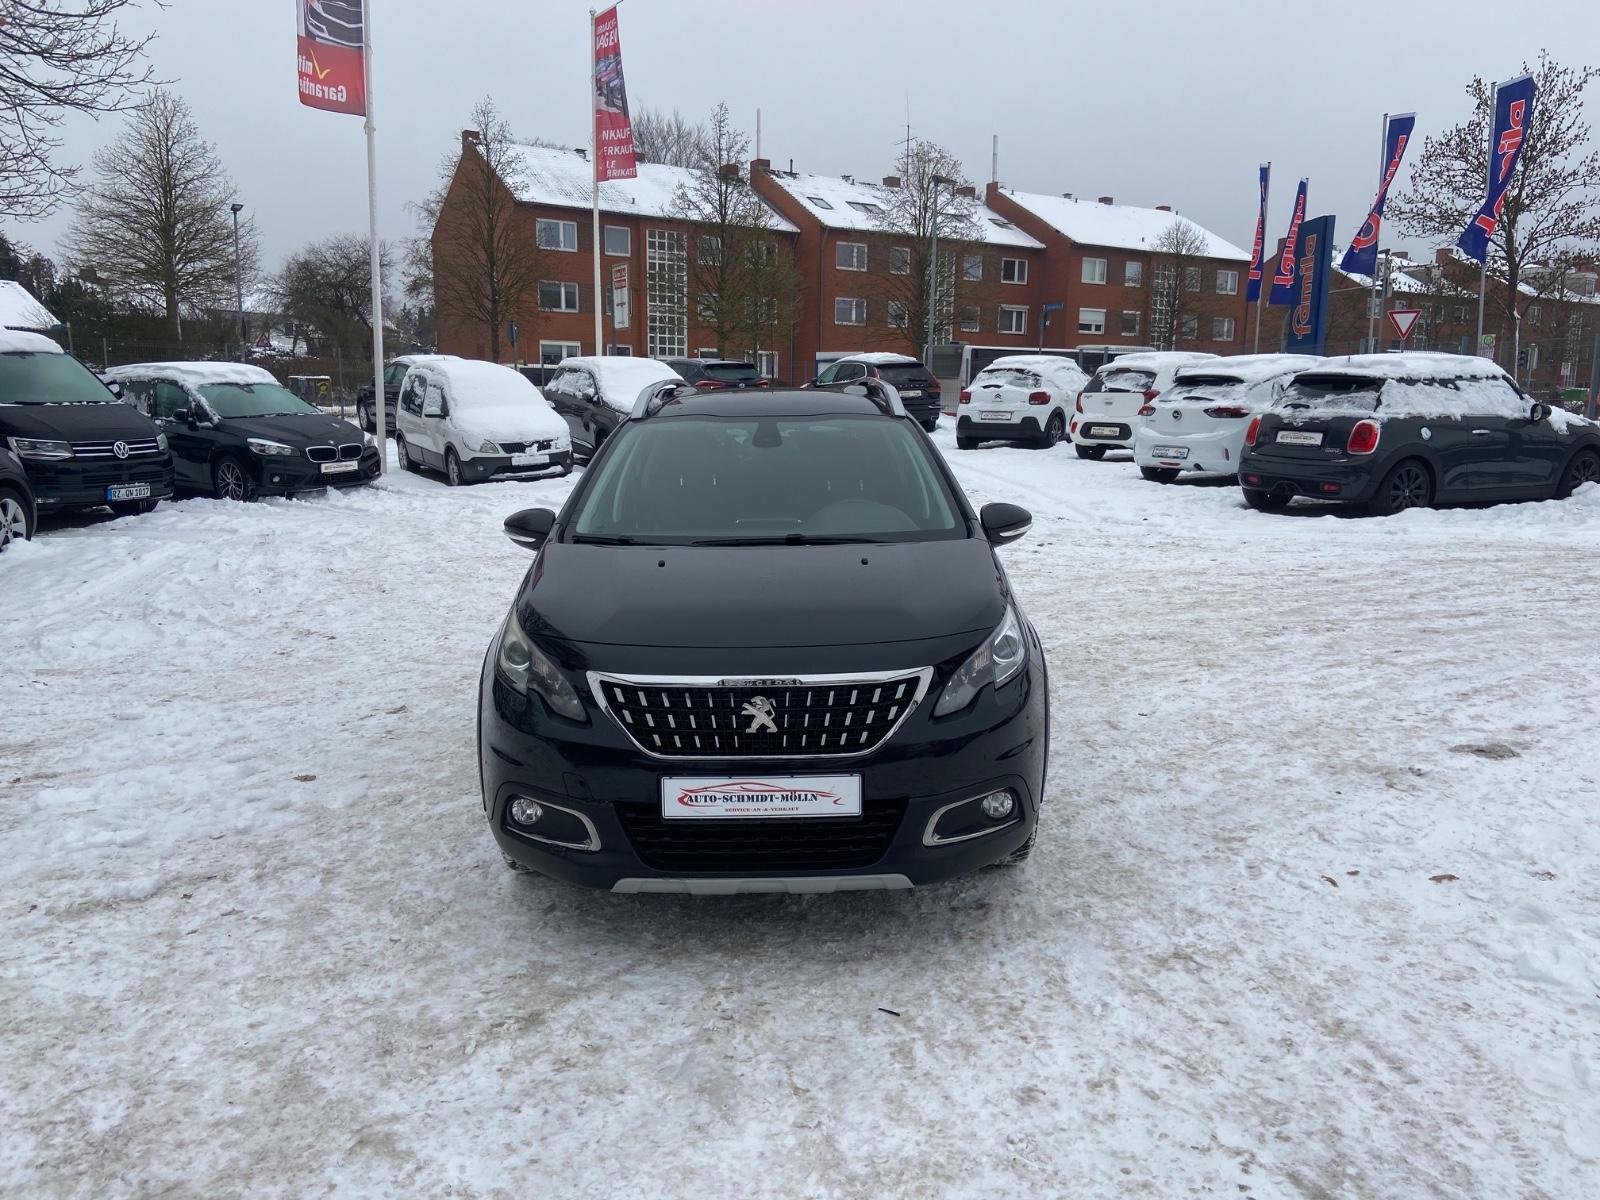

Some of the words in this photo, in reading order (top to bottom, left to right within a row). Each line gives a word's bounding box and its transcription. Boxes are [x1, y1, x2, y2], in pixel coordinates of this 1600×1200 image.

[602, 127, 631, 140] NKAUF
[603, 144, 634, 156] ERKAUF
[606, 160, 617, 168] LE
[606, 168, 637, 178] BRIKATE
[1292, 233, 1317, 340] famila
[112, 490, 121, 499] RZ
[686, 791, 818, 804] AUTO-SCHMIDT-MÖLLN
